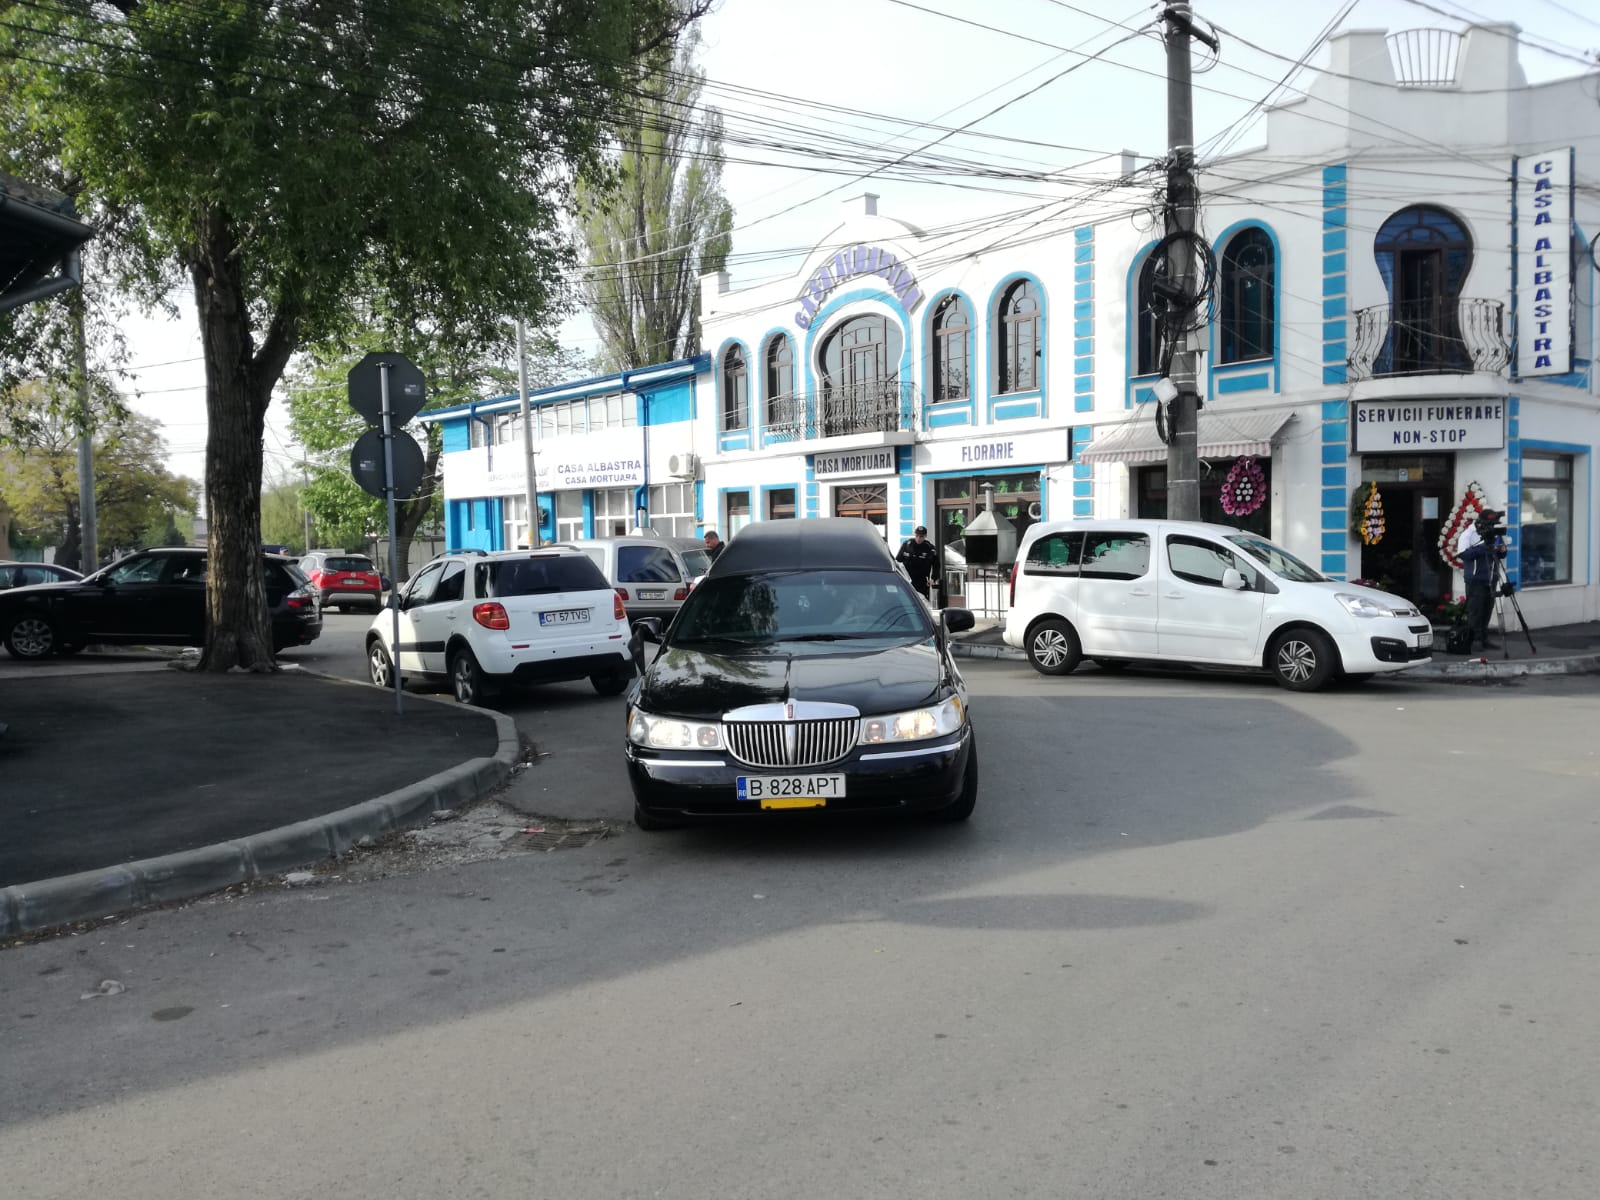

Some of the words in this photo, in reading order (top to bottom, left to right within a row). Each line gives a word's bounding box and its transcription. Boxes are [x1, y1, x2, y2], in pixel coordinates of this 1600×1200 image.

[1533, 160, 1553, 225] CASA
[1533, 237, 1553, 368] ALBASTRA
[1358, 407, 1422, 423] SERVICII
[1427, 406, 1501, 420] FUNERARE
[1393, 429, 1467, 444] NON-STOP
[961, 441, 1013, 462] FLORARIE
[557, 462, 584, 474] CASA
[587, 460, 643, 473] ALBASTRA
[816, 458, 839, 473] CASA
[841, 453, 891, 471] MORTUARA
[565, 476, 588, 485] CASA
[589, 473, 637, 484] MORTUARA
[545, 613, 556, 622] CT
[559, 612, 568, 621] 57
[570, 610, 588, 620] TVS
[750, 779, 763, 796] B
[770, 778, 802, 795] 828
[806, 777, 840, 795] APT
